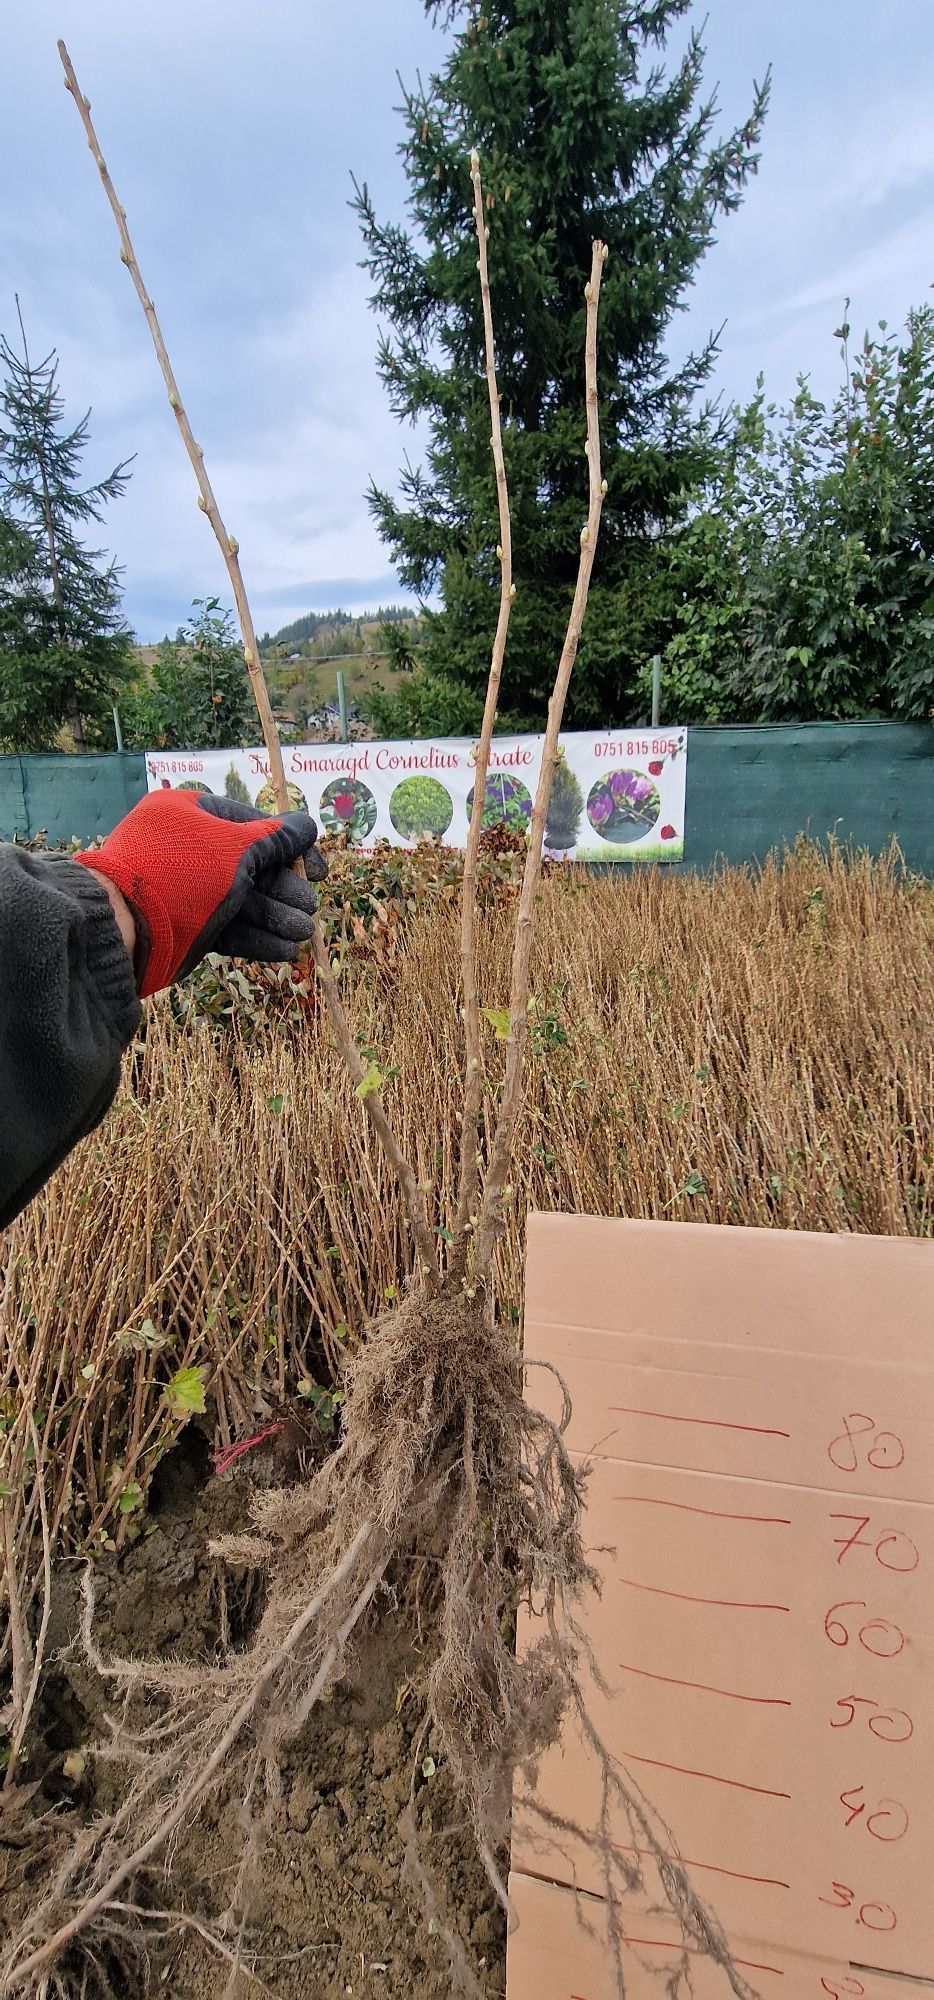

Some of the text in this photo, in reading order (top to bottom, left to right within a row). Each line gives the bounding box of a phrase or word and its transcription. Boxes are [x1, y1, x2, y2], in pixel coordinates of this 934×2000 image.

[171, 761, 186, 773] 815
[188, 760, 204, 773] 805
[291, 749, 370, 781] Smaragd
[375, 746, 460, 770] Cornelius
[594, 739, 676, 757] 0751 815 805
[828, 1412, 905, 1472] 80
[829, 1512, 920, 1572] 70
[825, 1601, 904, 1658] 60
[830, 1694, 914, 1743] 50
[840, 1784, 909, 1842] 40
